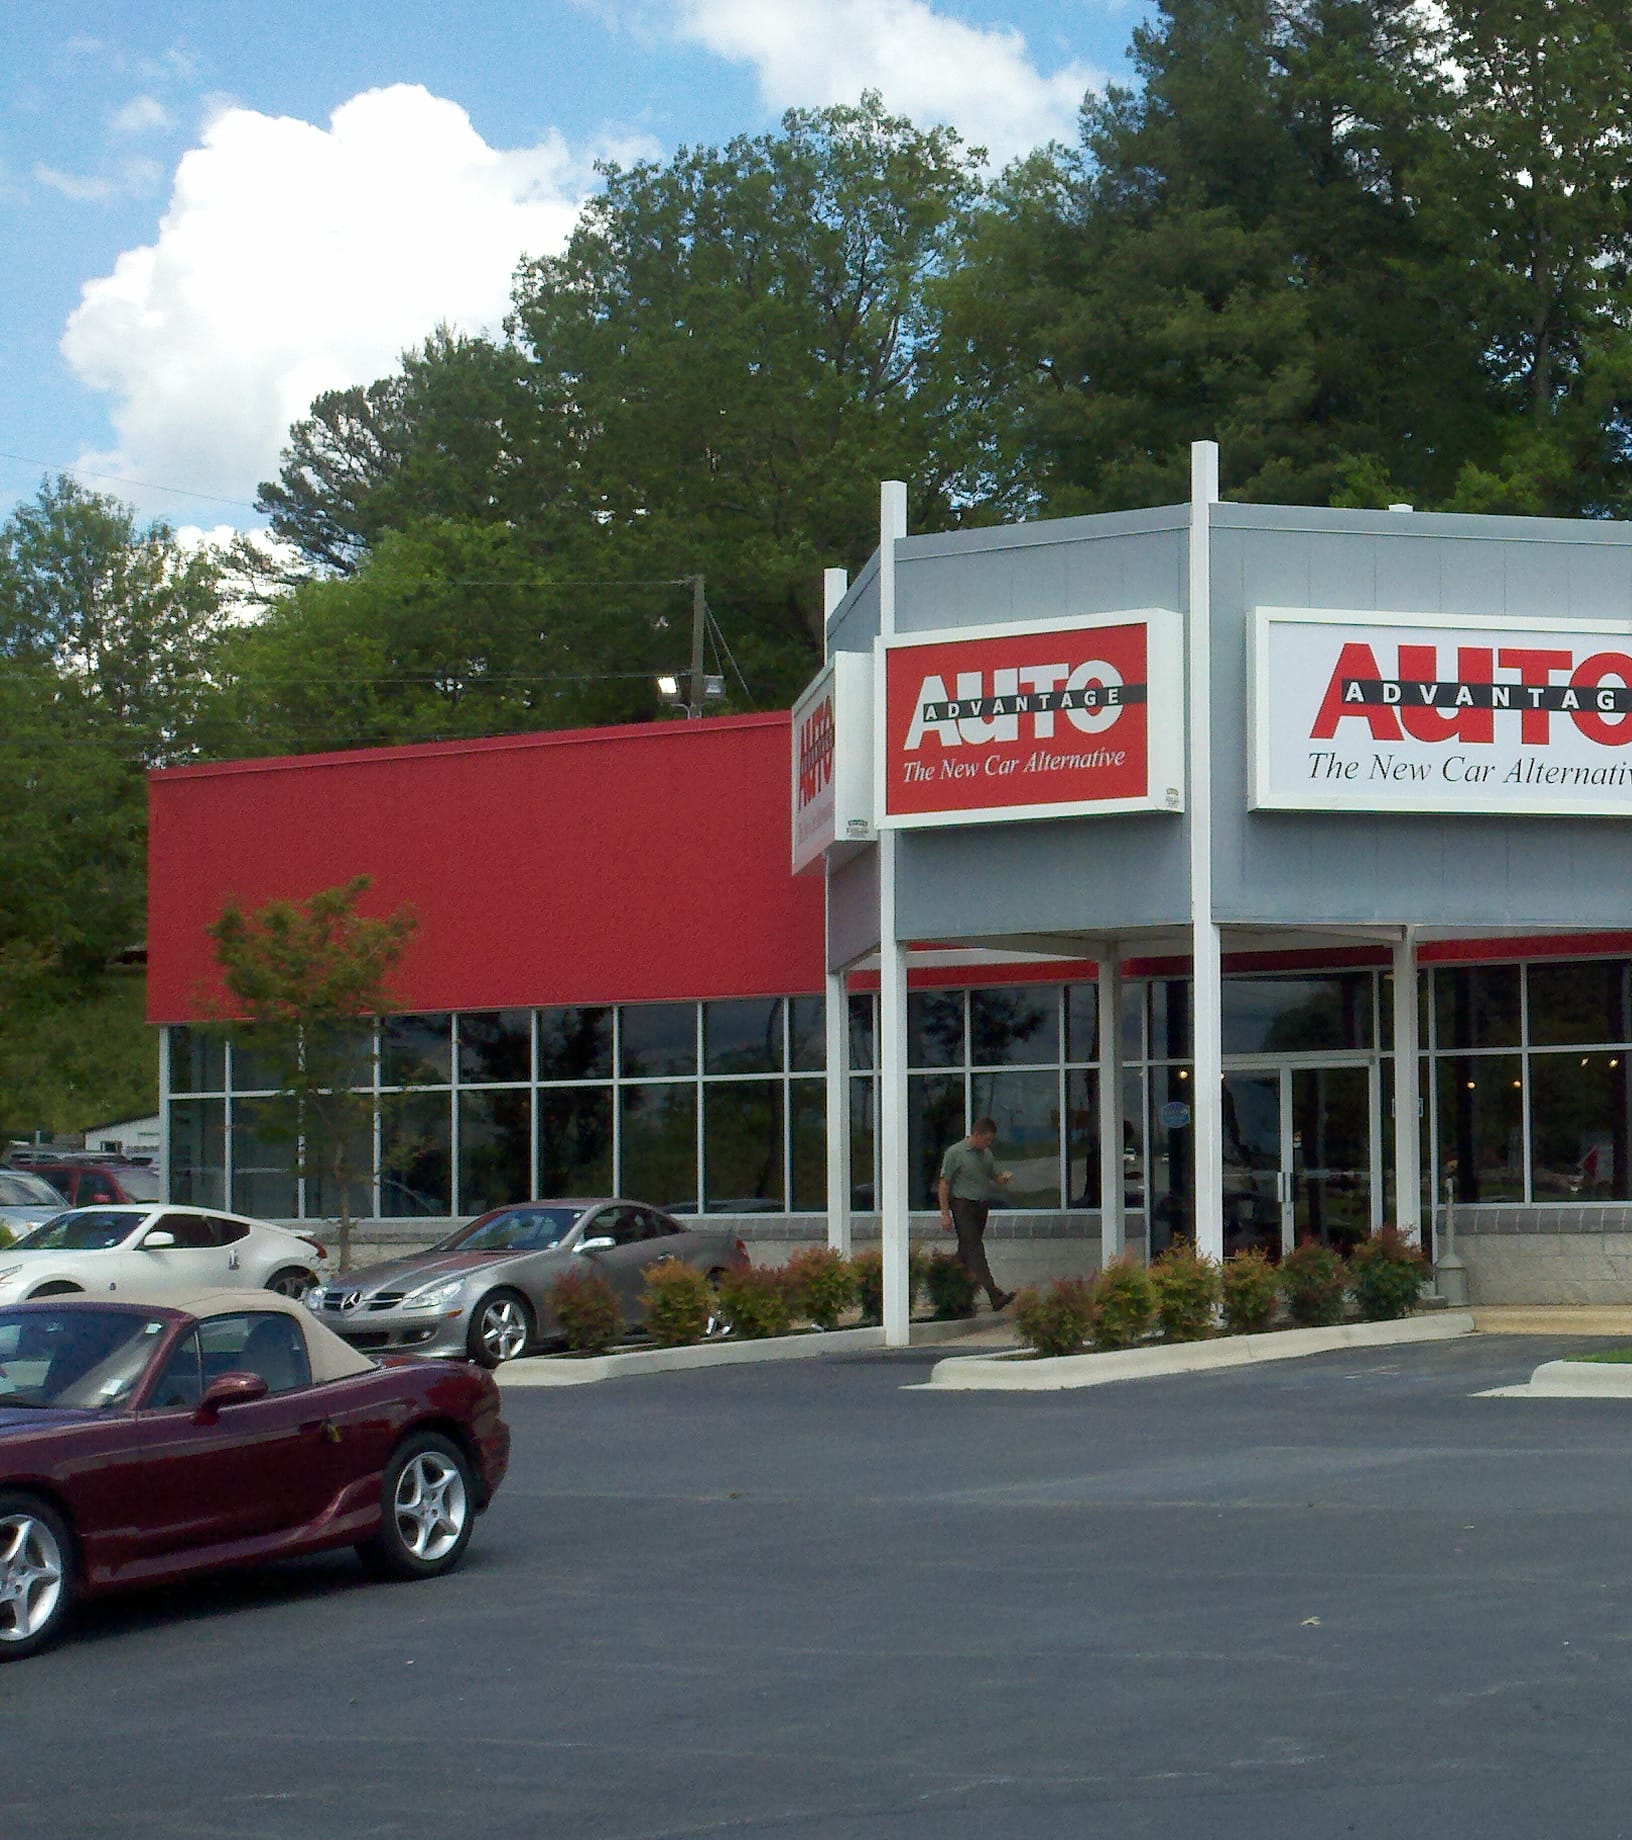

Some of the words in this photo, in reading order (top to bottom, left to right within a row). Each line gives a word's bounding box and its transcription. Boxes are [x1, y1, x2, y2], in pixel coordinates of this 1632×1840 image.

[903, 659, 1124, 750] AUTO
[925, 688, 1120, 720] ADVANTAGE
[903, 760, 934, 783] The
[939, 758, 980, 780] New
[984, 754, 1020, 776] Car
[1023, 746, 1126, 773] Alternative
[1308, 751, 1360, 780] The
[1369, 753, 1433, 781] New
[1442, 755, 1496, 784] Car
